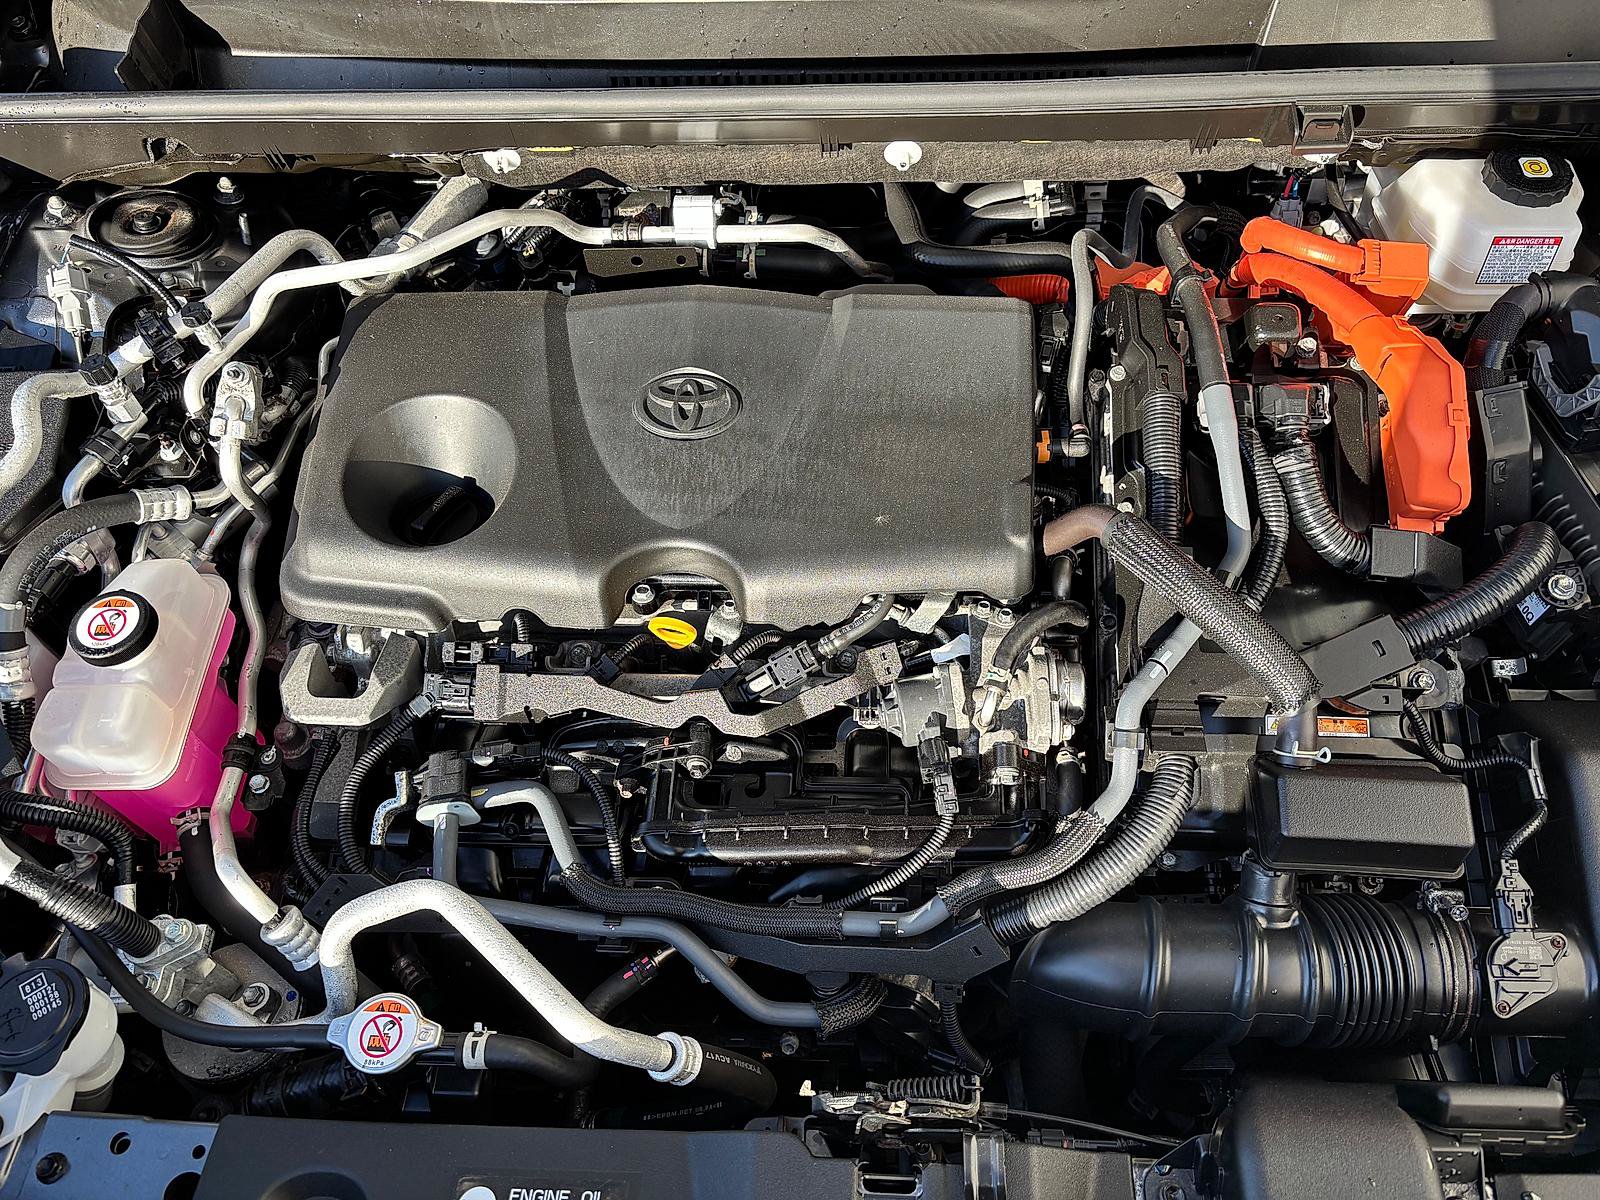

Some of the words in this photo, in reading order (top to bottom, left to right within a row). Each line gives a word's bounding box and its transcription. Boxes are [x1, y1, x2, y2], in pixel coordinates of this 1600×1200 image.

[25, 978, 43, 993] 813
[27, 983, 56, 1005] 000127
[30, 991, 60, 1012] 000128
[32, 998, 62, 1020] 000145
[508, 1188, 571, 1200] ENGINE
